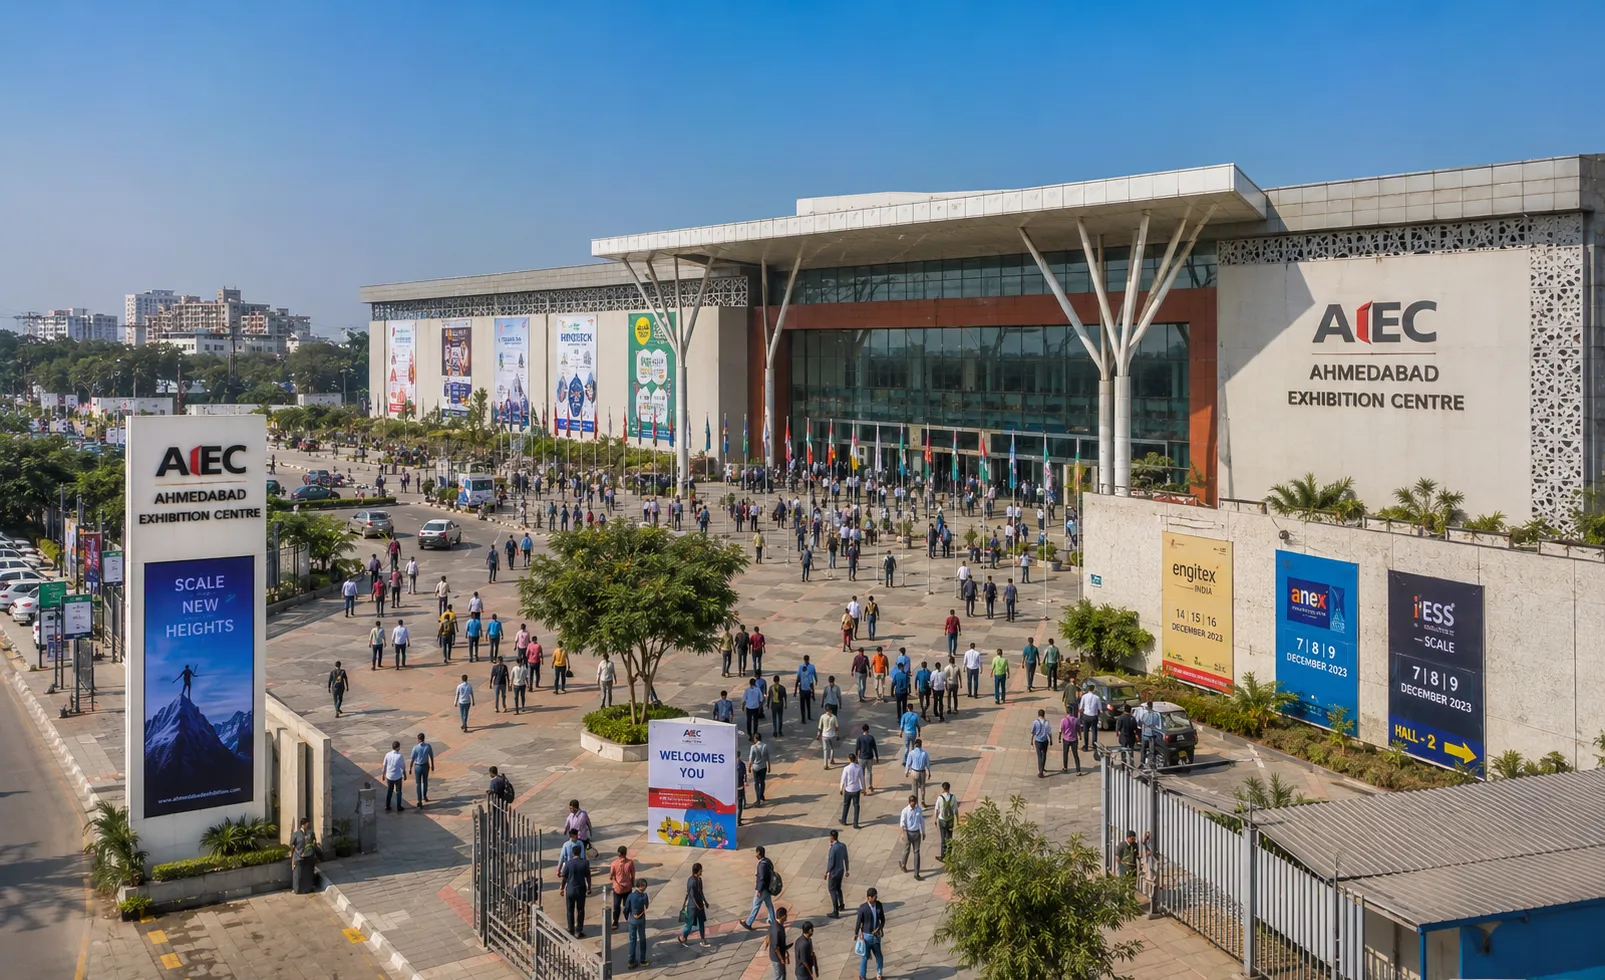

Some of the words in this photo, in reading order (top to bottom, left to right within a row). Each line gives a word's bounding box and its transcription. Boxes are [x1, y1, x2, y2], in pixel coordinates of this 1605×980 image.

[1310, 364, 1440, 382] AHMEDABAD
[1288, 391, 1384, 408] EXHIBITION
[1391, 393, 1464, 411] CENTRE
[154, 489, 246, 504] AHMEDABAD
[138, 510, 210, 524] EXHIBITION
[214, 508, 261, 520] CENTRE
[1172, 563, 1216, 583] engitex
[175, 576, 224, 592] SCALE
[1194, 584, 1212, 595] INDIA
[182, 598, 218, 614] NEW
[1291, 588, 1326, 610] anex
[166, 619, 234, 638] HEIGHTS
[1172, 622, 1206, 638] DECEMBER
[1208, 632, 1223, 642] 2023
[1424, 636, 1455, 653] SCALE
[1287, 652, 1326, 672] DECEMBER
[1329, 664, 1348, 677] 2023
[1401, 682, 1447, 705] DECEMBER
[1450, 697, 1472, 713] 2023
[1394, 724, 1418, 744] HALL
[1427, 734, 1436, 750] 2
[660, 750, 725, 763] WELCOMES
[680, 768, 704, 779] YOU
